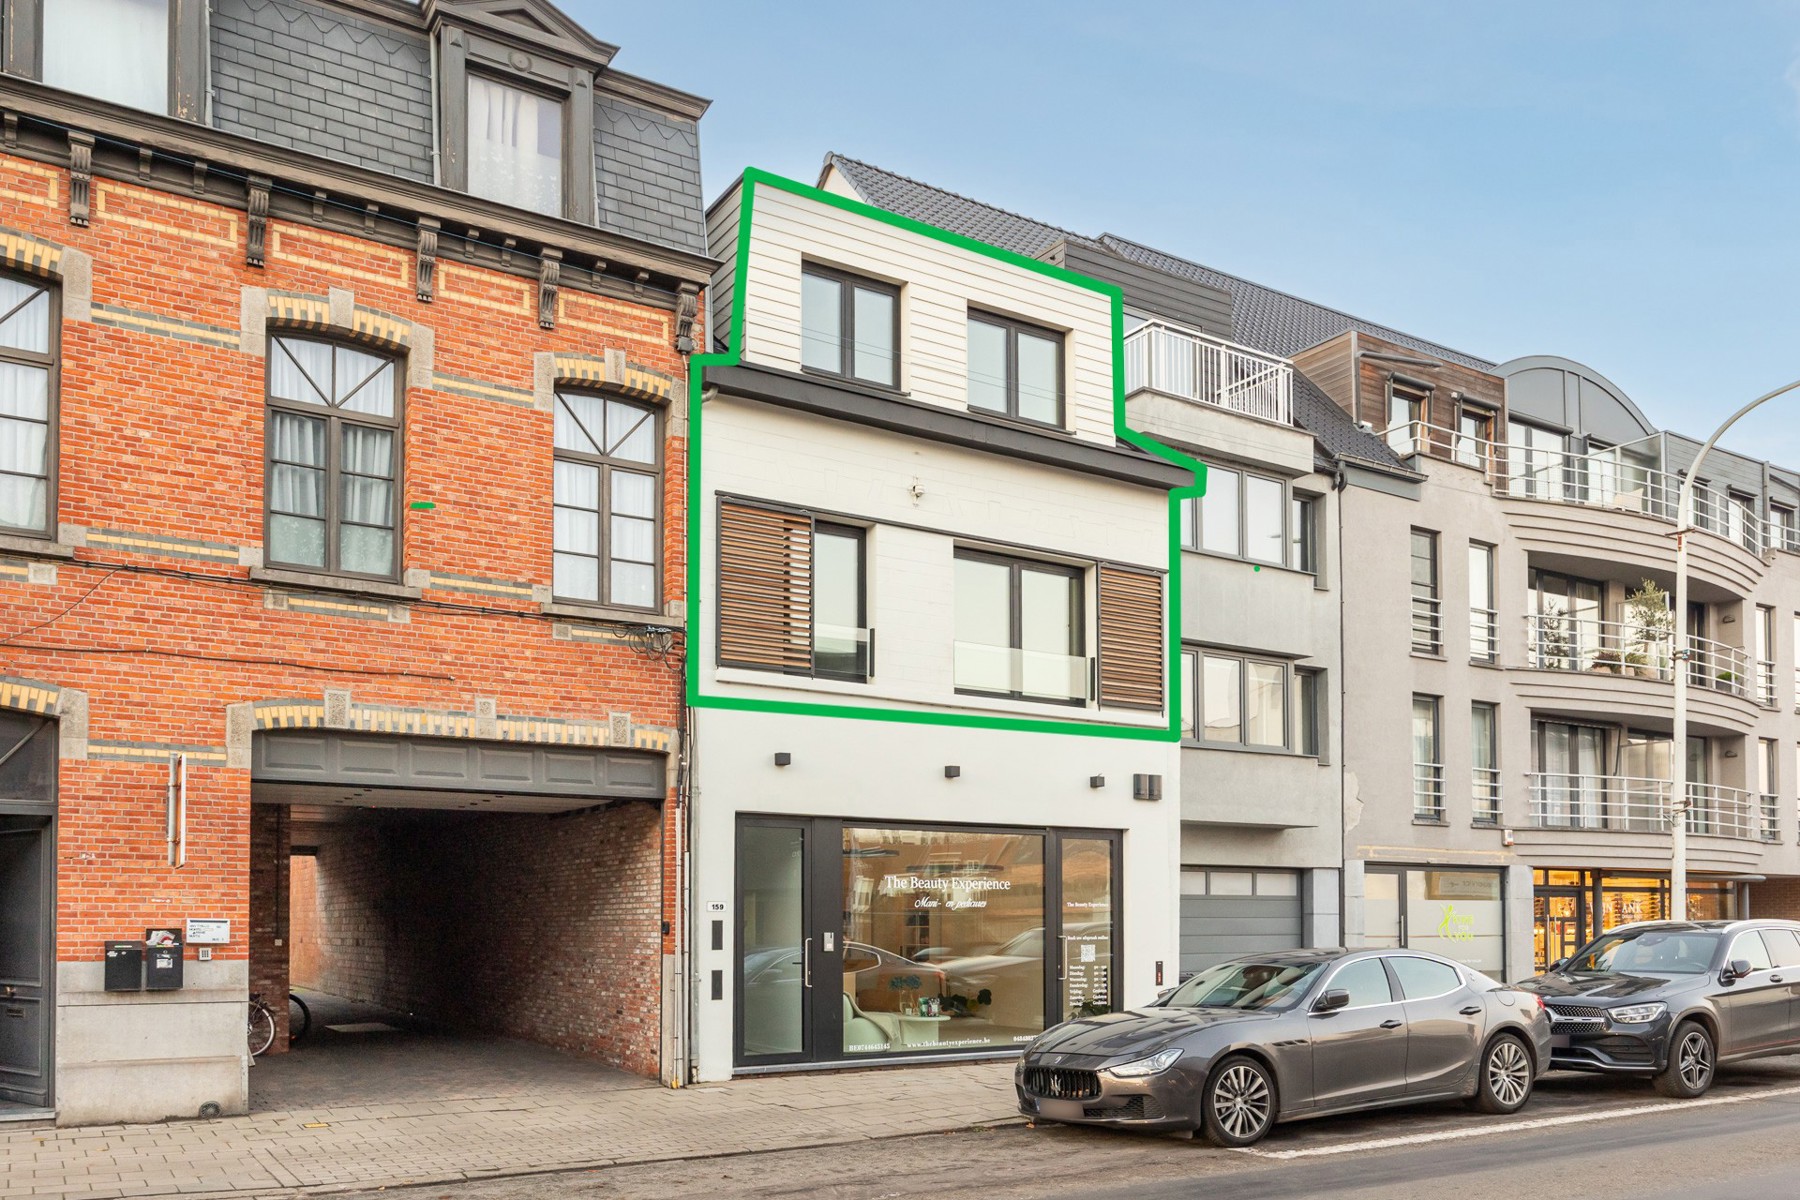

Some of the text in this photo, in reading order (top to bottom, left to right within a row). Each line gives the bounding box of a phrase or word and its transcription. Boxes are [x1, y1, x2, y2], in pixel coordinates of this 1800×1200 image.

[884, 875, 1011, 893] The Beauty Experience
[711, 903, 724, 911] 159
[906, 1036, 991, 1047] www.thebeautyexperience.be
